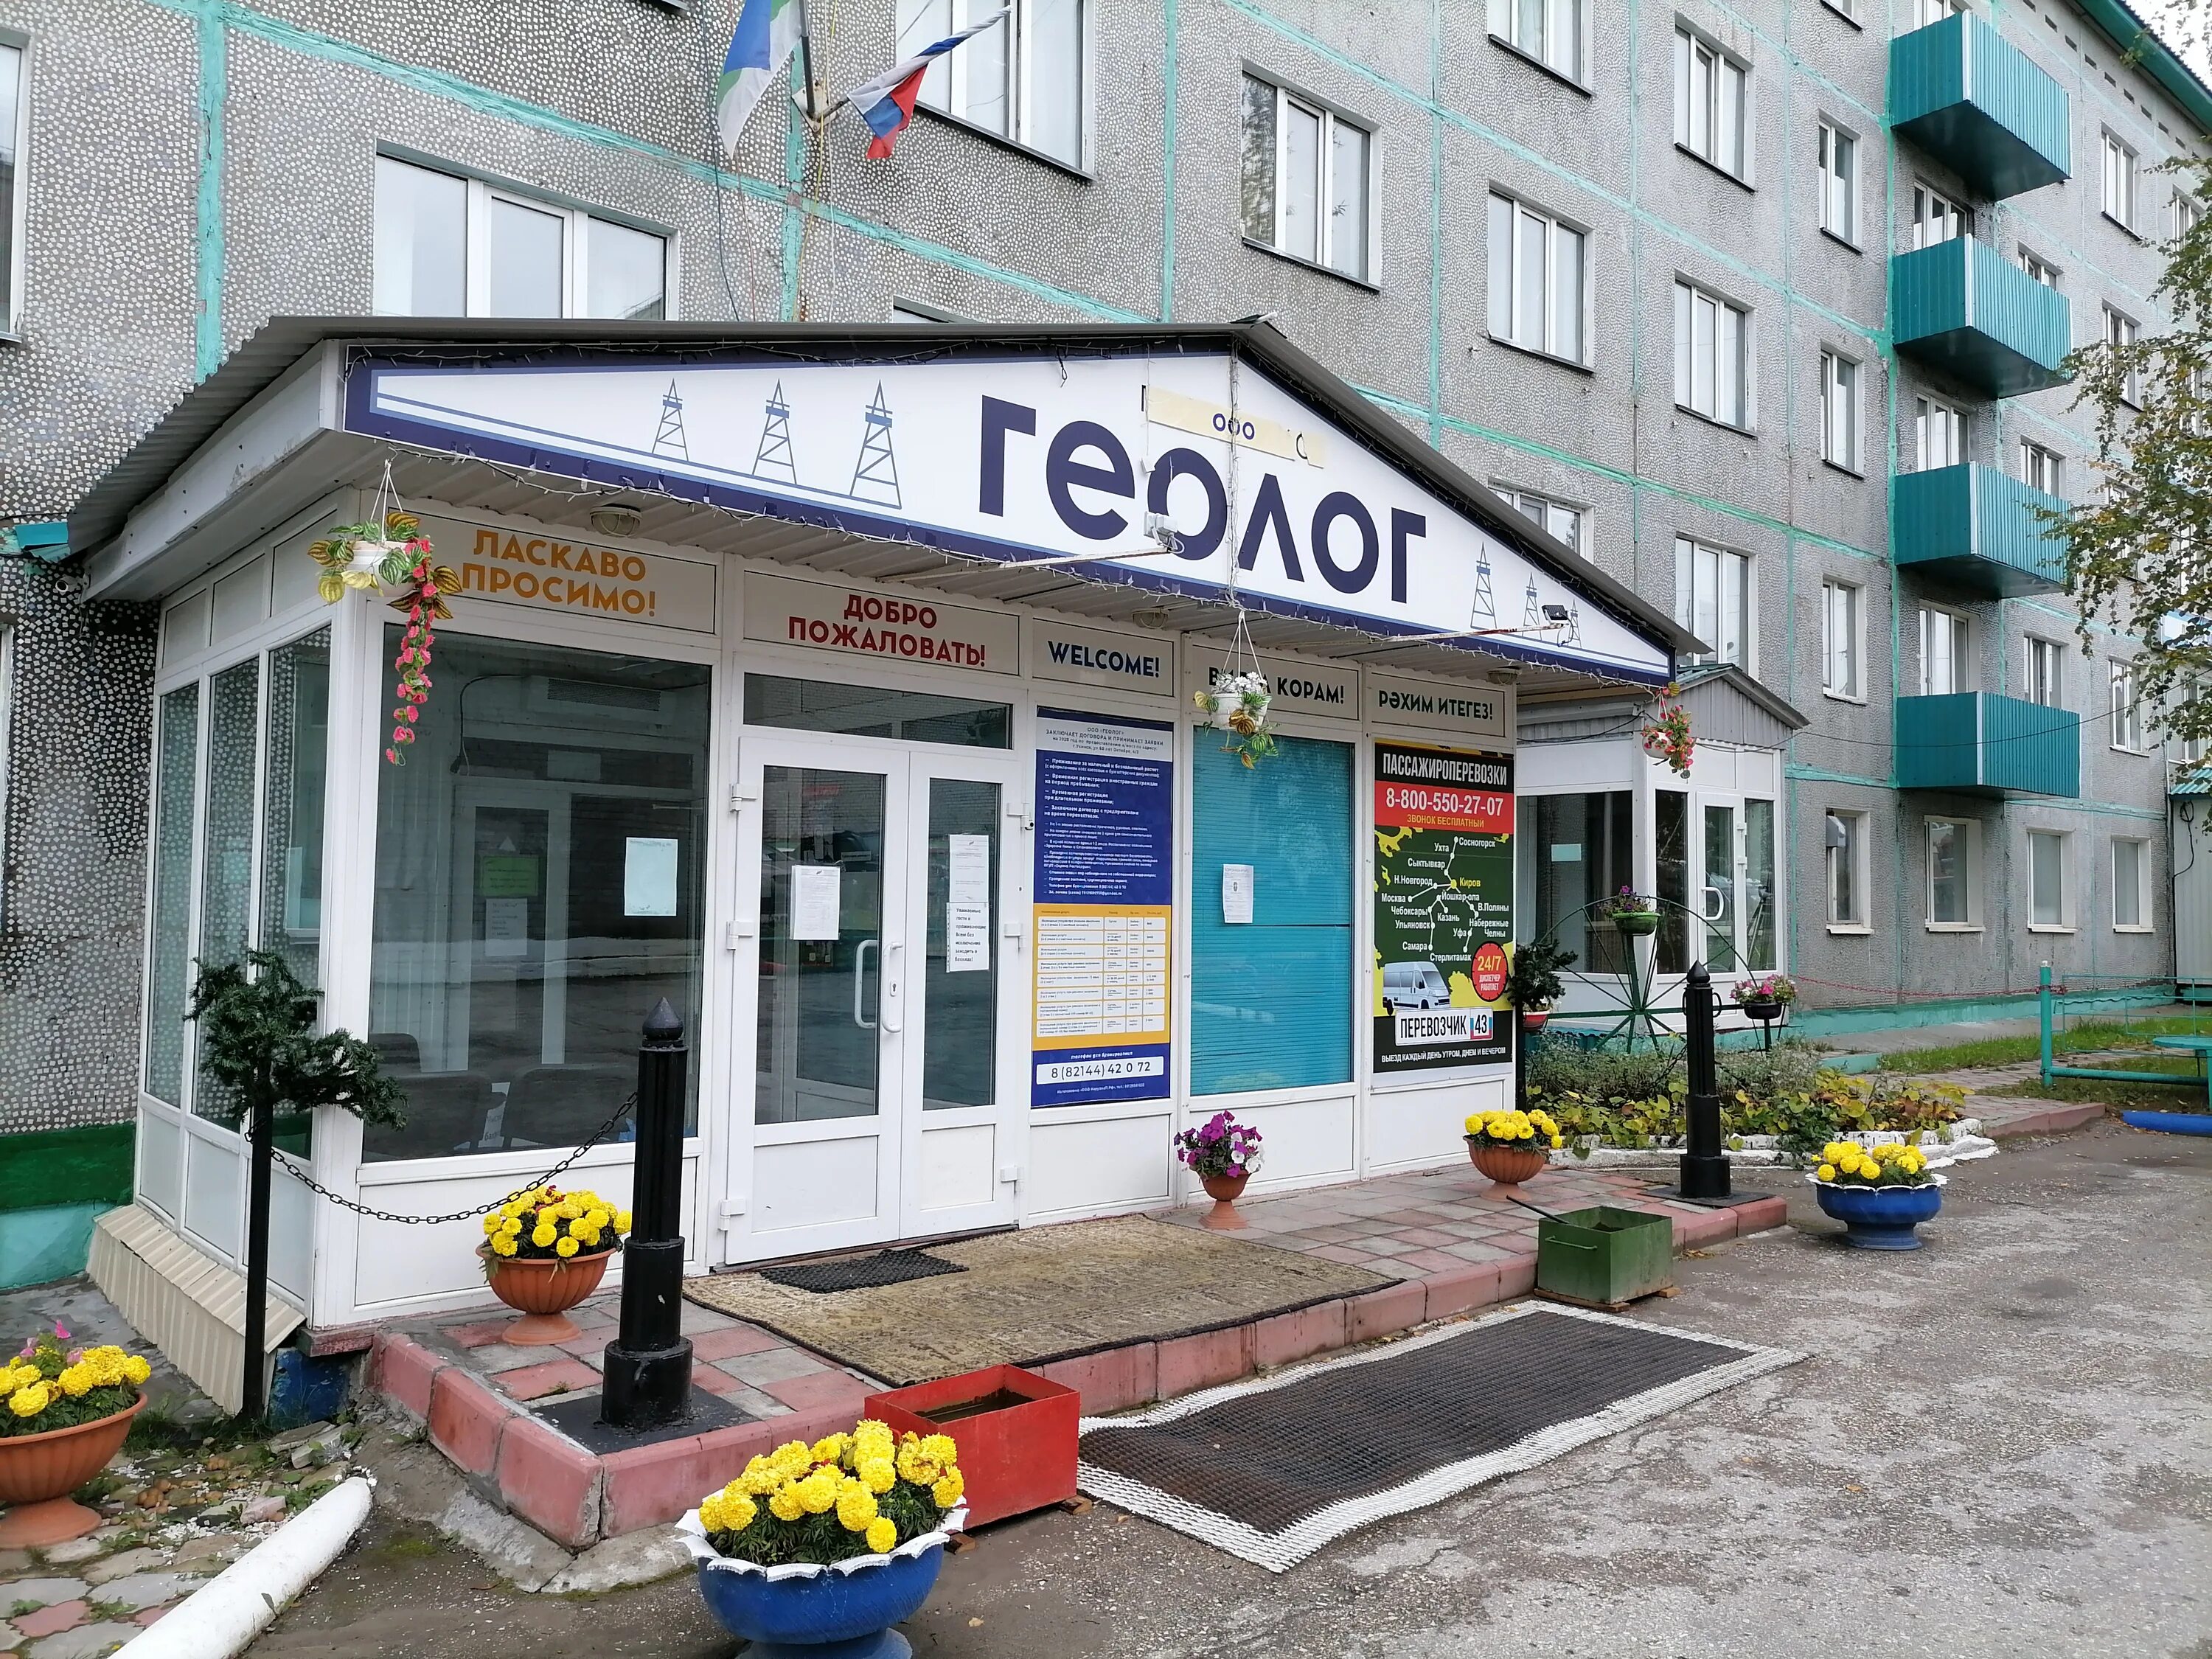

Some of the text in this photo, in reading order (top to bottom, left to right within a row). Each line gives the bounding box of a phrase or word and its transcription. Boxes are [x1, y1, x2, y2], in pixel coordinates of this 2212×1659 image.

[473, 529, 646, 582] ЛАСКАВО
[462, 564, 655, 617] ПРОСИМО!
[844, 594, 936, 629] ДОБРО
[789, 617, 987, 667] ПОЖАЛОВАТЬ!
[1048, 641, 1160, 678] WELCOME!
[1277, 676, 1344, 704] КОРАМ!
[1379, 690, 1493, 720] РӘХИМ ИТЕГЕЗ!
[1113, 736, 1144, 744] ПРИНИМАЕТ
[1382, 753, 1507, 786] ПАССАЖИРОПЕРЕВОЗКИ
[1385, 787, 1503, 816] 8-800-550-27-07
[1407, 814, 1484, 828] ЗВОНОК БЕСПЛАТНЫЙ
[1434, 843, 1449, 853] Ухта
[1458, 837, 1495, 849] Сосногорск
[1408, 858, 1445, 869] Сыктывкар
[1394, 875, 1433, 887] Н.Новгород
[1459, 877, 1481, 888] Киров
[1382, 893, 1405, 902] Москва
[1391, 906, 1428, 917] Чебоксары
[1478, 902, 1509, 912] В.Поляны
[1437, 913, 1460, 922] Казань
[1469, 919, 1509, 928] Набережные
[1395, 920, 1430, 930] Ульяновск
[1453, 928, 1467, 939] Уфа
[1484, 928, 1506, 938] Челны
[1402, 942, 1427, 951] Самара
[1430, 953, 1471, 961] Стерлитамак
[1477, 955, 1501, 971] 24/7
[1400, 1015, 1487, 1039] ПЕРЕВОЗЧИК 43
[1381, 1054, 1402, 1062] ВЫЕЗД
[1402, 1051, 1426, 1061] КАЖДЫЙ
[1427, 1051, 1441, 1060] ДЕНЬ
[1461, 1048, 1477, 1057] ДНЕМ
[1482, 1046, 1506, 1055] ВЕЧЕРОМ
[1051, 1061, 1150, 1080] 8 (82144) 42 0 72
